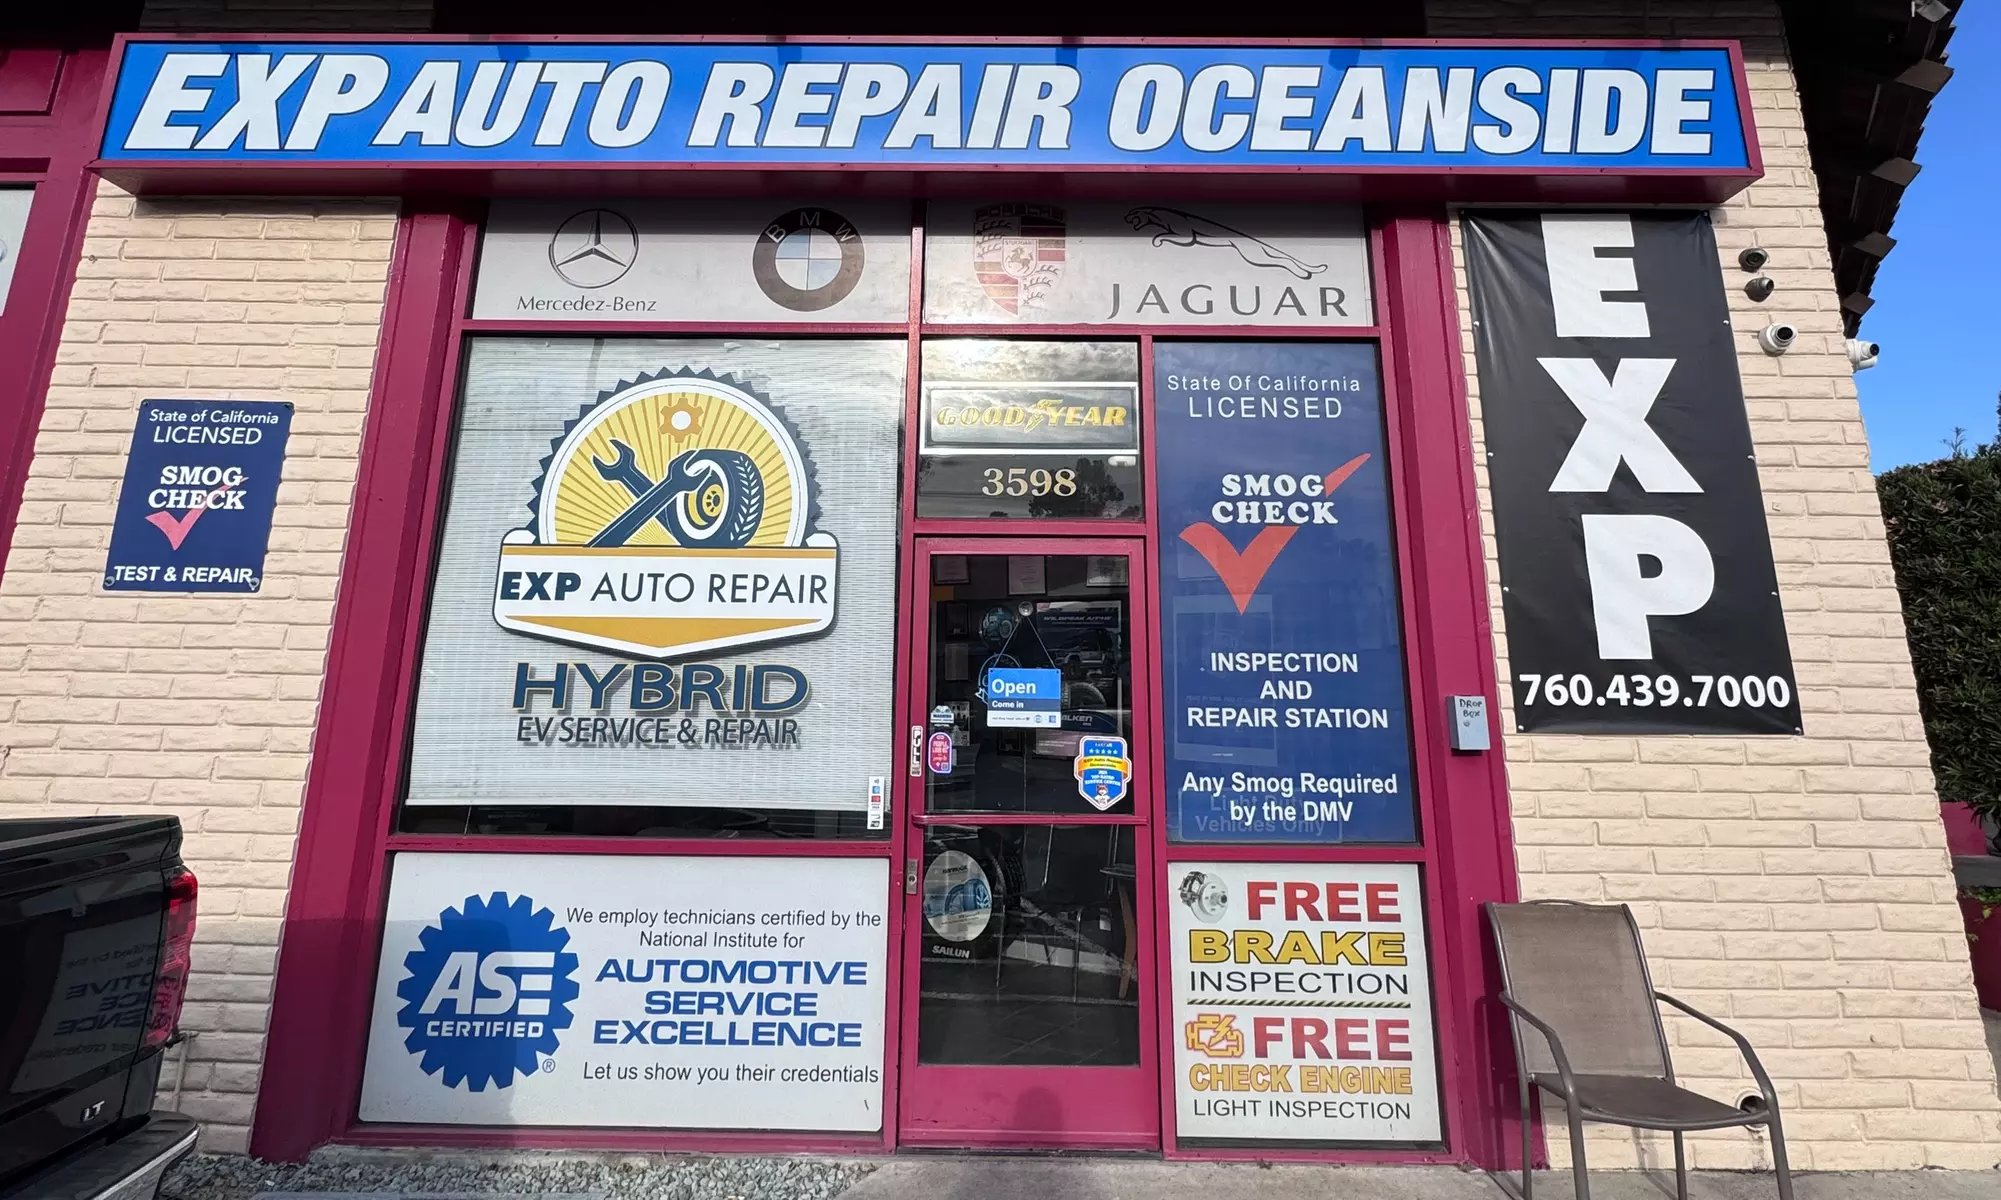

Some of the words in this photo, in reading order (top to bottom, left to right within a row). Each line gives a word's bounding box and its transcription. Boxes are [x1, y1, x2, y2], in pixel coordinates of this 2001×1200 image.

[122, 52, 390, 151] EXP
[371, 59, 673, 148] AUTO
[685, 61, 1082, 150] REPAIR
[1107, 63, 1714, 155] OCEANSIDE
[764, 211, 859, 244] BMW
[516, 295, 657, 312] Mercedez-Benz
[1107, 283, 1349, 320] JAGUAR
[1167, 375, 1221, 391] State
[1228, 375, 1251, 391] Of
[1258, 375, 1361, 391] California
[149, 409, 187, 422] State
[191, 409, 209, 422] of
[210, 410, 279, 425] California
[1188, 396, 1342, 418] LICENSED
[153, 426, 262, 445] LICENSED
[160, 465, 243, 486] SMOG
[981, 467, 1077, 497] 3598
[1221, 473, 1325, 497] SMOG
[148, 488, 247, 510] CHECK
[1211, 501, 1339, 524] CHECK
[114, 565, 161, 582] TEST
[163, 566, 177, 582] &
[182, 567, 253, 584] REPAIR
[499, 571, 582, 601] EXP
[589, 572, 695, 602] AUTO
[708, 573, 829, 605] REPAIR
[1210, 652, 1359, 673] INSPECTION
[511, 661, 811, 712] HYBRID
[991, 678, 1037, 697] Open
[1259, 680, 1313, 700] AND
[1518, 673, 1790, 708] 760.439.7000
[991, 700, 1015, 709] Come
[1016, 700, 1024, 709] in
[1187, 707, 1278, 728] REPAIR
[1284, 708, 1389, 729] STATION
[517, 716, 554, 742] EV
[559, 717, 669, 744] SERVICE
[676, 718, 697, 744] &
[704, 718, 798, 744] REPAIR
[913, 730, 921, 764] PULL
[1182, 772, 1224, 797] Any
[1231, 771, 1294, 798] Smog
[1300, 773, 1398, 798] Required
[1230, 800, 1256, 825] by
[1262, 801, 1297, 822] the
[1303, 801, 1354, 822] DMV
[1246, 881, 1401, 923] FREE
[566, 907, 593, 924] We
[598, 908, 658, 928] employ
[663, 909, 756, 926] technicians
[761, 910, 826, 927] certified
[831, 910, 850, 930] by
[855, 911, 881, 927] the
[639, 931, 707, 948] National
[713, 931, 778, 948] Institute
[783, 932, 805, 948] for
[1188, 928, 1408, 967] BRAKE
[932, 944, 970, 959] SAILUN
[594, 958, 868, 985] AUTOMOTIVE
[1189, 970, 1408, 995] INSPECTION
[418, 951, 555, 1016] ASE
[644, 990, 818, 1016] SERVICE
[426, 1020, 544, 1038] CERTIFIED
[593, 1020, 862, 1047] EXCELLENCE
[1253, 1016, 1413, 1061] FREE
[583, 1062, 611, 1080] Let
[617, 1066, 638, 1080] us
[644, 1062, 692, 1081] show
[697, 1067, 729, 1085] you
[735, 1063, 776, 1082] their
[780, 1064, 879, 1083] credentials
[1188, 1063, 1293, 1093] CHECK
[1300, 1065, 1413, 1095] ENGINE
[81, 1100, 105, 1123] LT
[1193, 1098, 1261, 1117] LIGHT
[1269, 1100, 1411, 1120] INSPECTION
